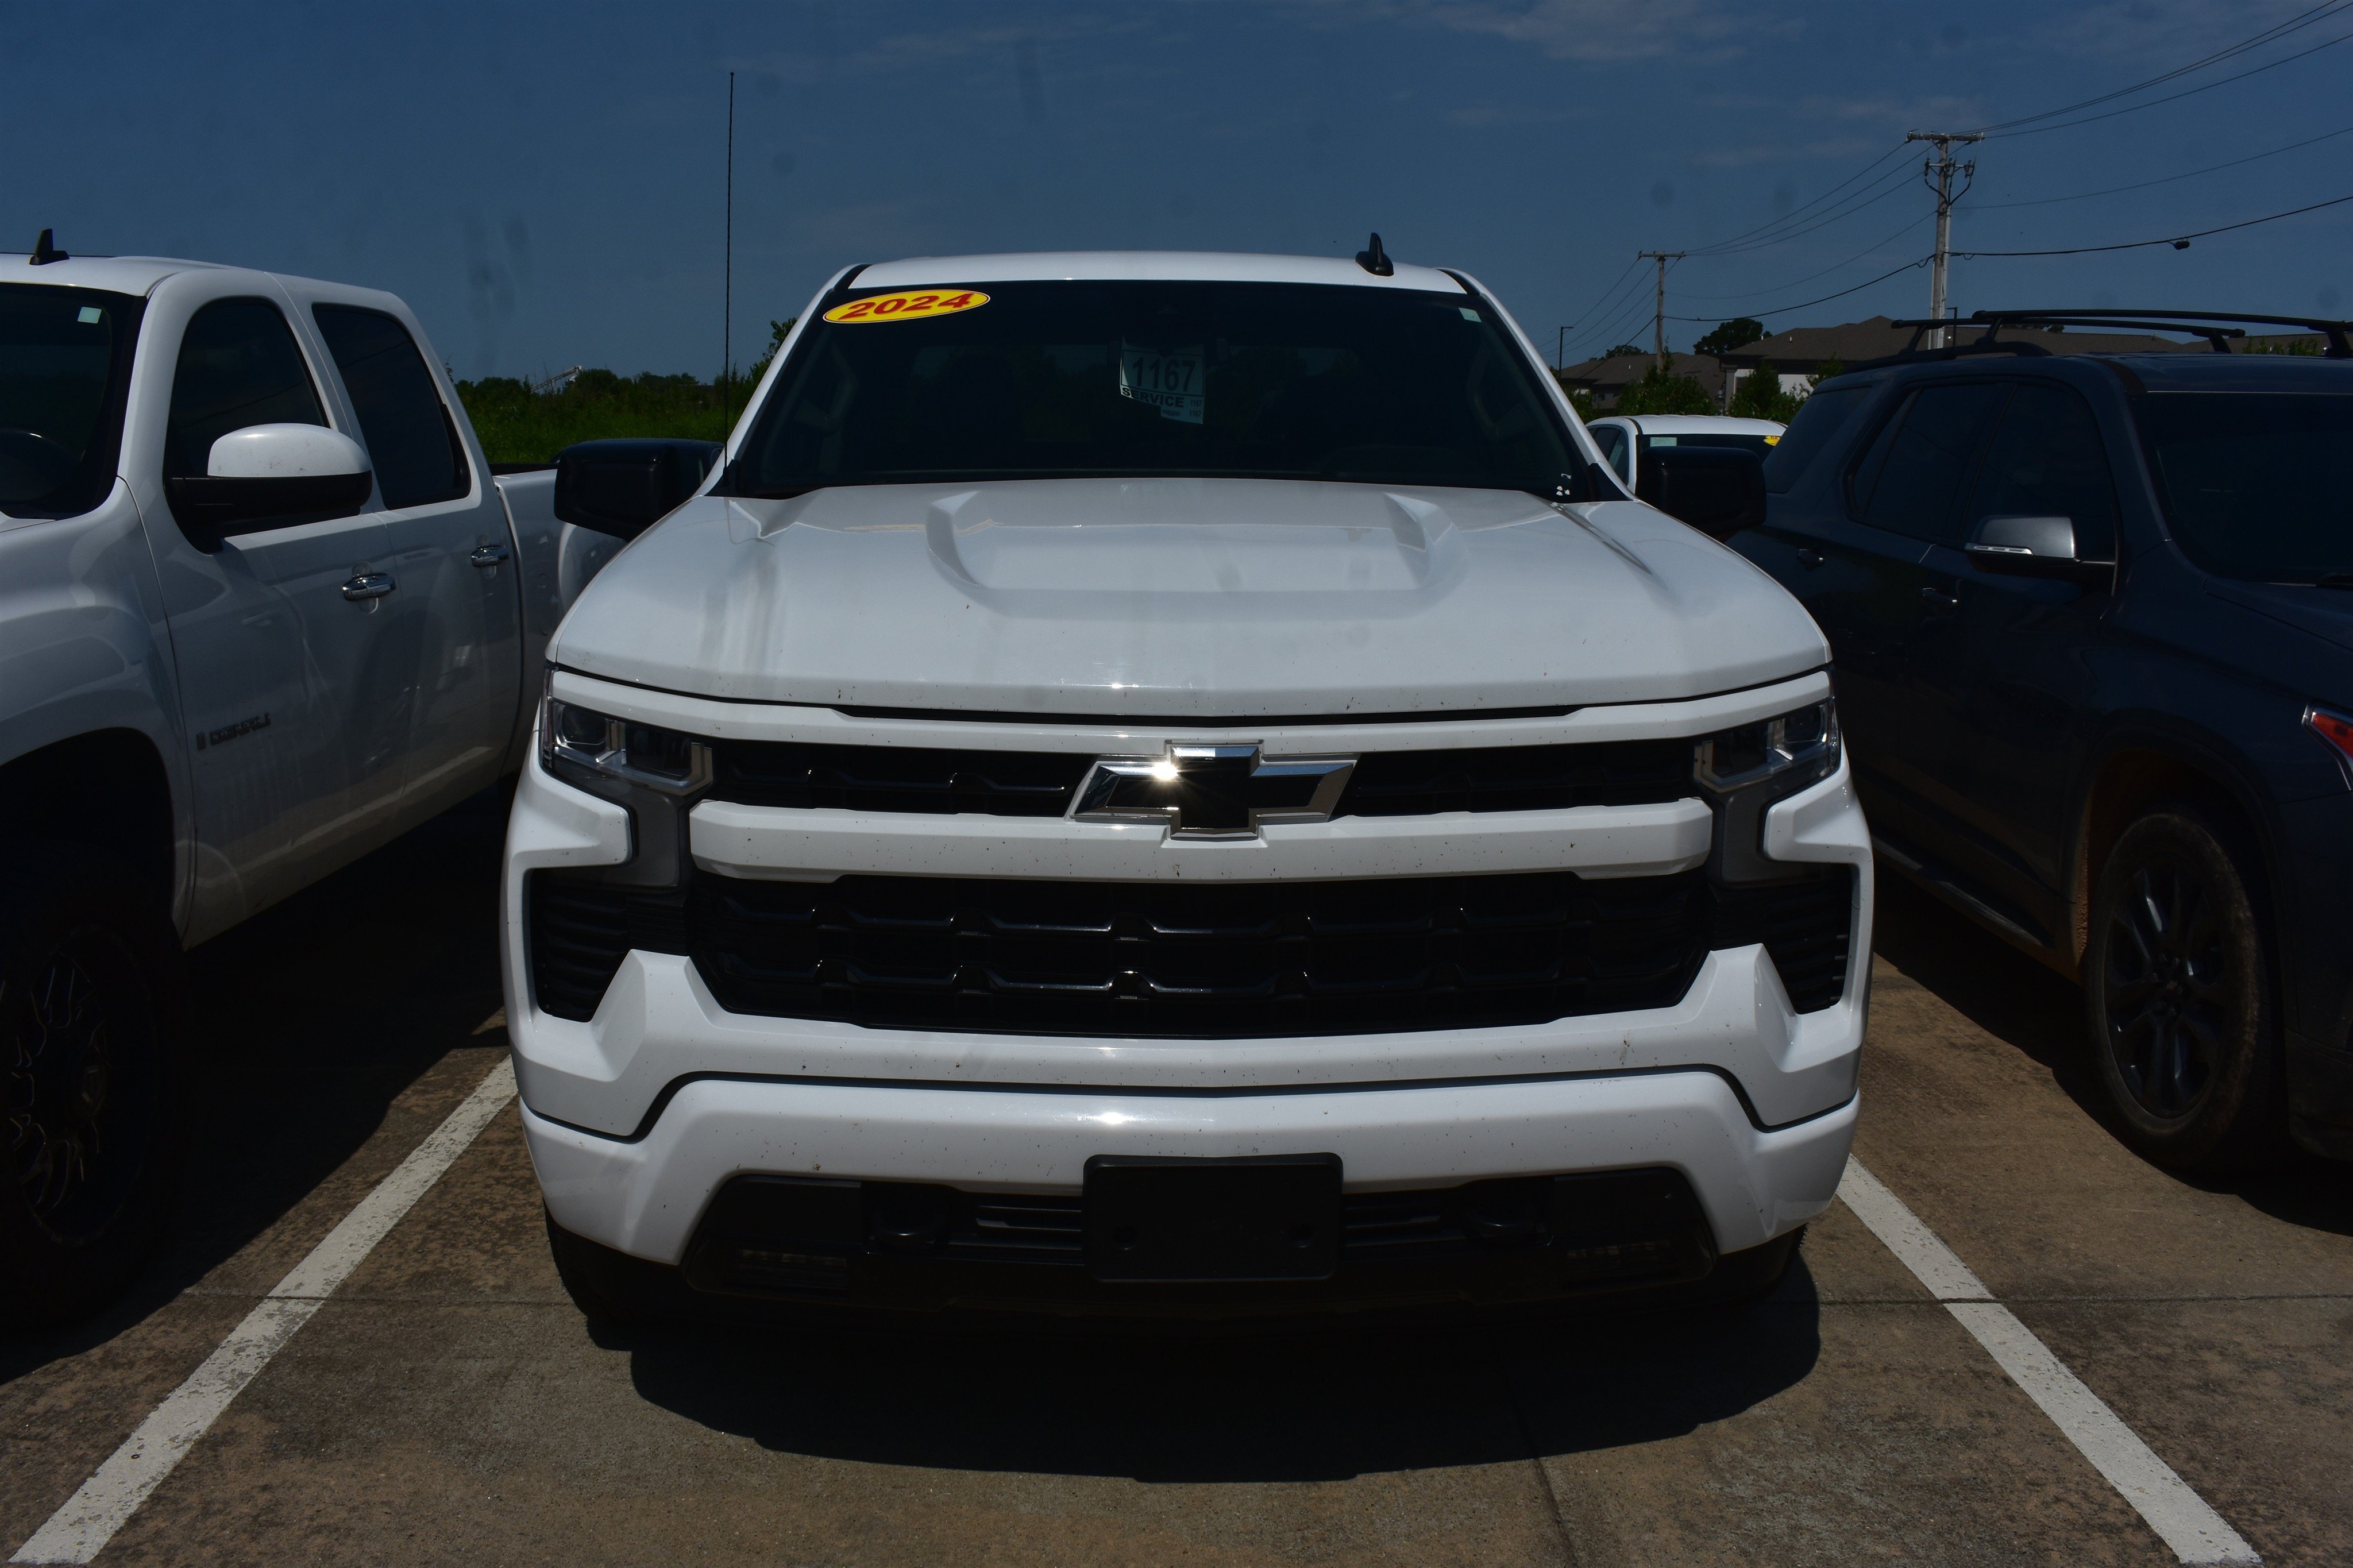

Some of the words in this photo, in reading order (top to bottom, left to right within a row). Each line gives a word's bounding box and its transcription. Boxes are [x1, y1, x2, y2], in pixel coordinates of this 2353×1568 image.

[838, 293, 974, 320] 2024
[1132, 357, 1195, 392] 1167
[1122, 387, 1184, 408] SERVICE
